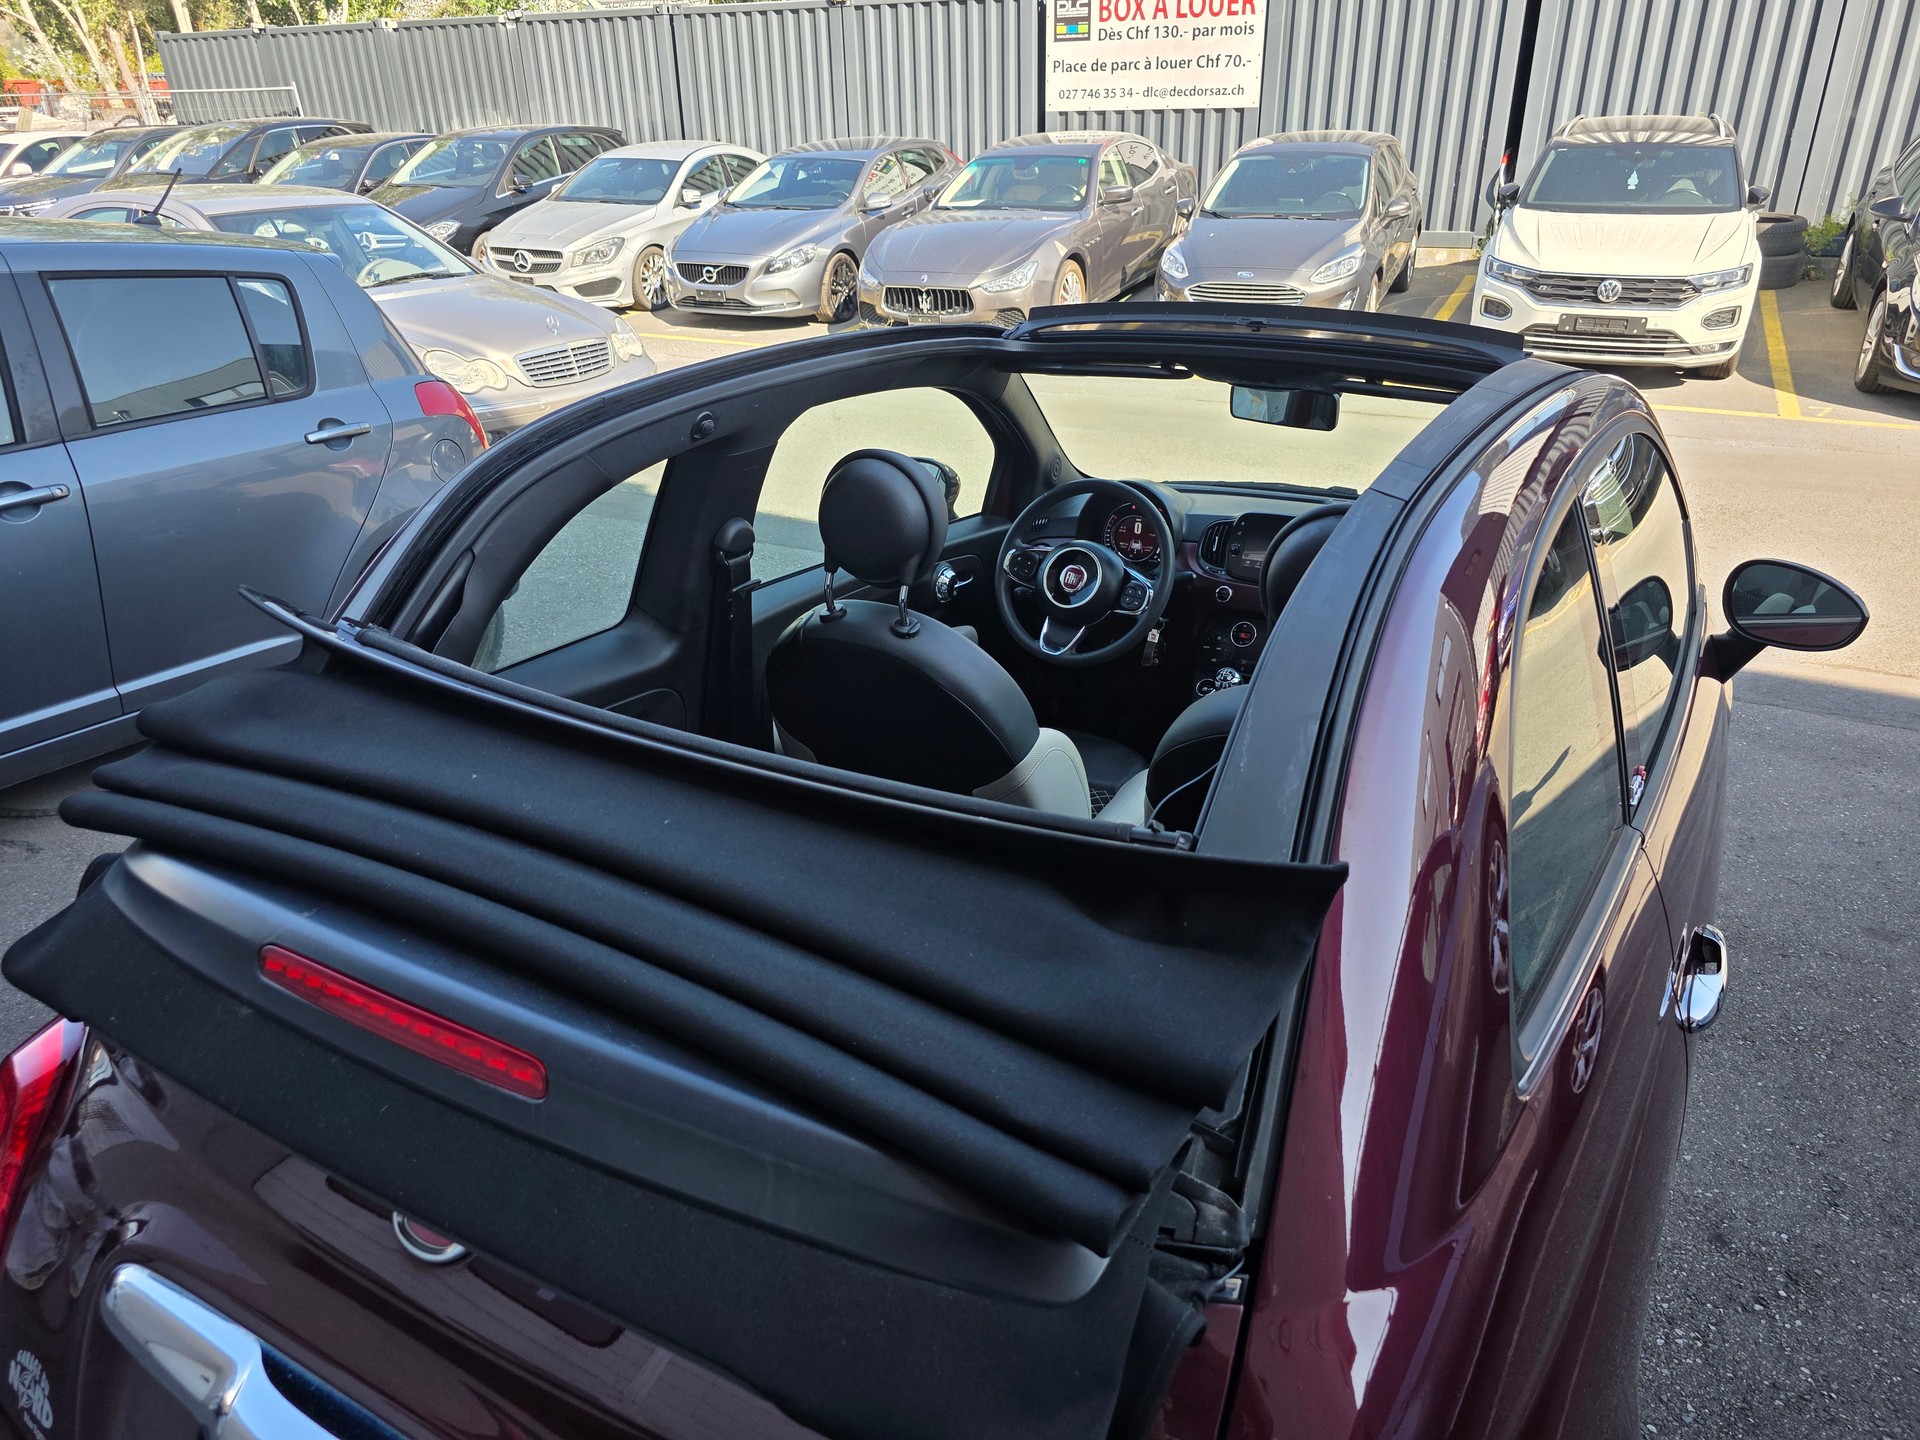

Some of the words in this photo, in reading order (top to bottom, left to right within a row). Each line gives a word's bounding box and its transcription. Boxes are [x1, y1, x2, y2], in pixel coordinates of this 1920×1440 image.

[1099, 0, 1146, 22] BOX
[1176, 0, 1256, 19] LOUER
[1098, 27, 1123, 41] Dès
[1126, 25, 1150, 40] Chf
[1154, 25, 1189, 39] 130.-
[1192, 26, 1217, 41] par
[1220, 21, 1255, 36] mois
[1053, 59, 1087, 73] Place
[1091, 58, 1107, 72] de
[1111, 60, 1141, 75] parc
[1144, 56, 1152, 70] à
[1155, 56, 1193, 70] louer
[1196, 53, 1222, 68] Chf
[1224, 54, 1252, 68] 70.-
[1058, 89, 1078, 99] 027
[1080, 88, 1101, 99] 746
[1103, 88, 1117, 98] 35
[1119, 87, 1133, 98] 34
[1142, 84, 1244, 99] dlc@decdorsaz.ch
